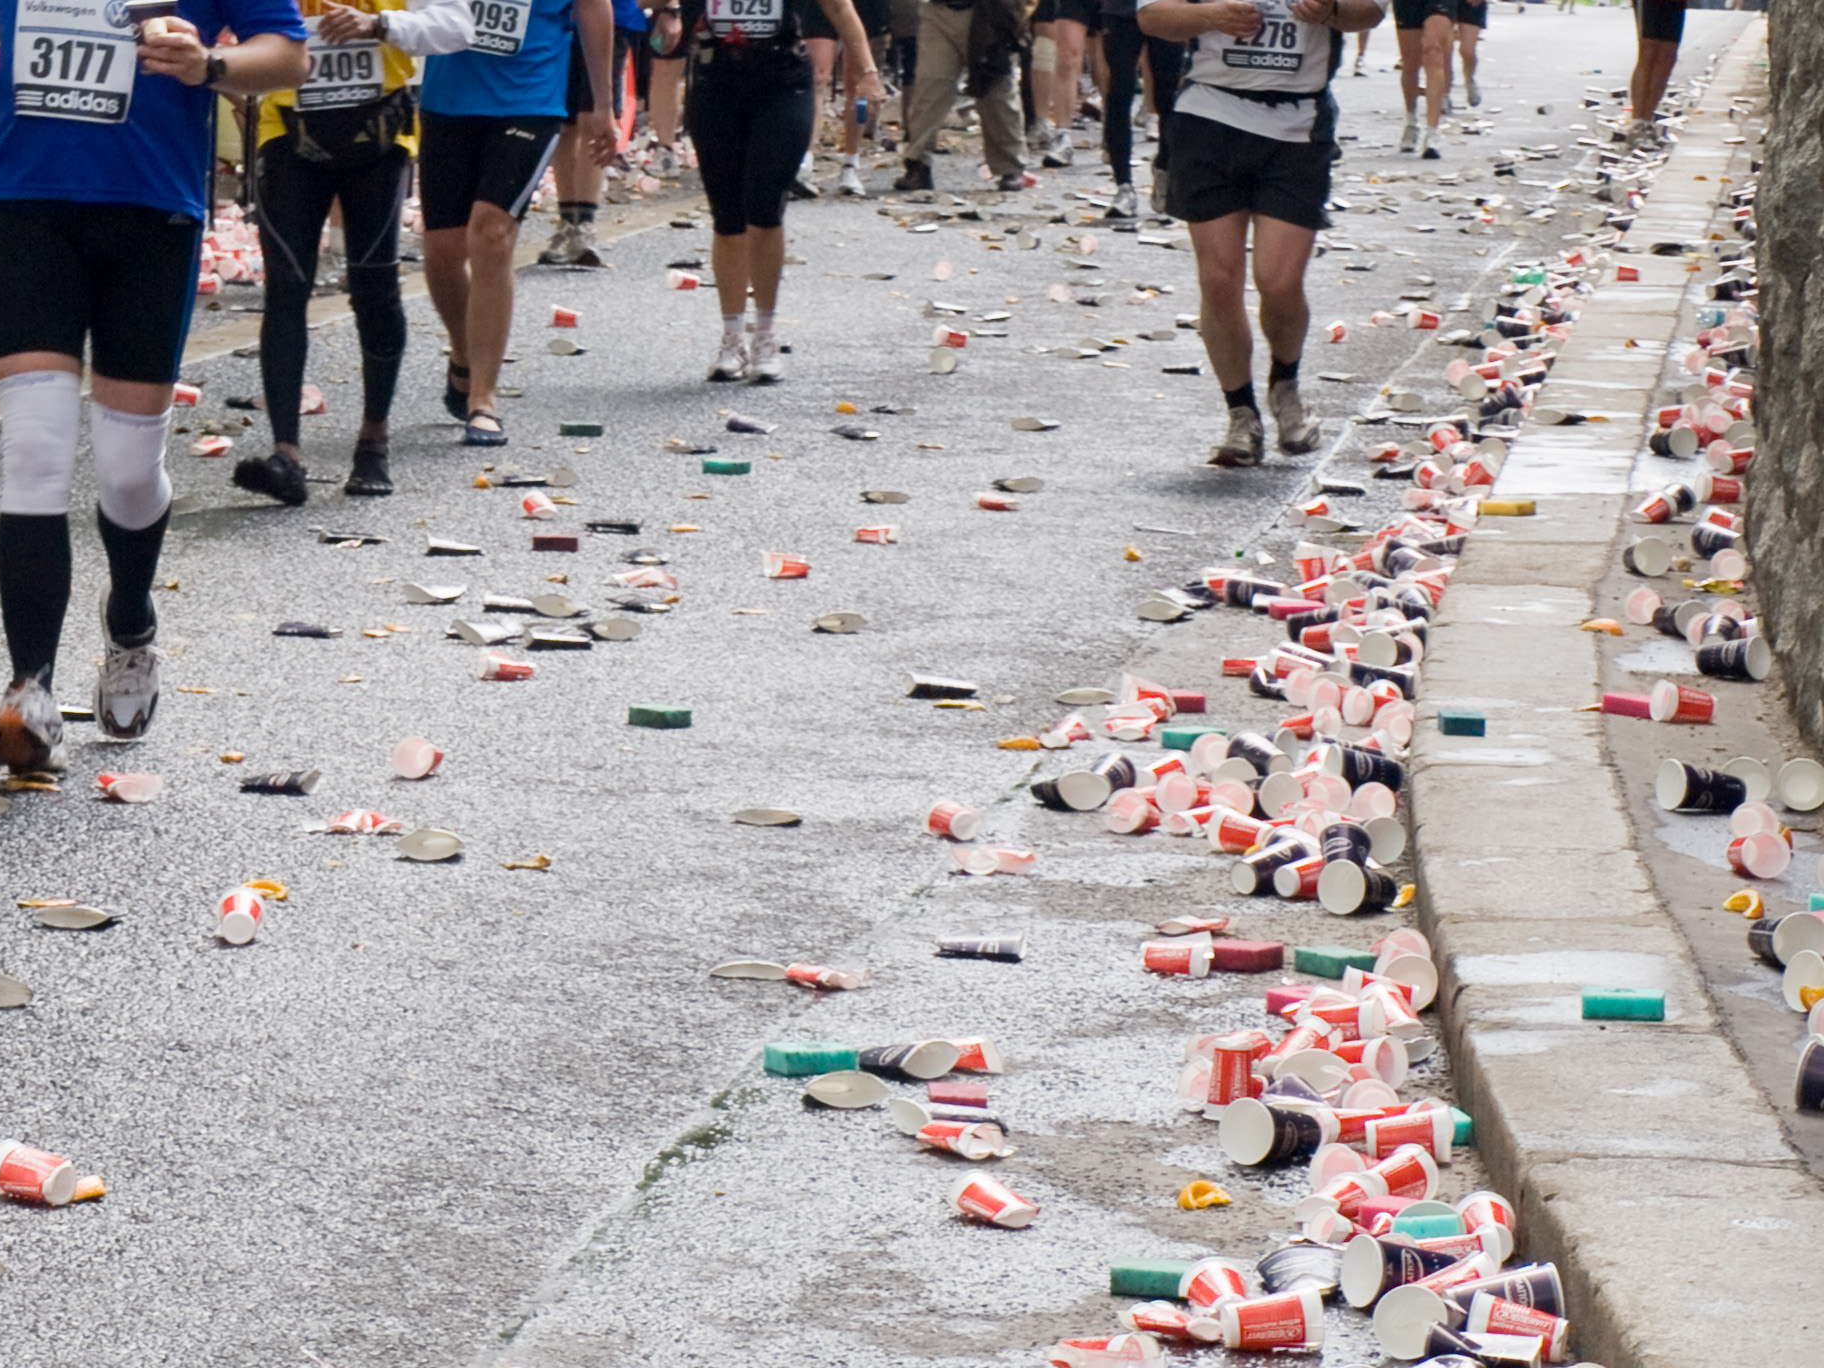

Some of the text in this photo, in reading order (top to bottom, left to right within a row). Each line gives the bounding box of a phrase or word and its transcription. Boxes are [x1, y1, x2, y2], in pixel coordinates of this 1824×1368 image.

[25, 0, 96, 17] Volkswagen
[30, 37, 116, 84] 3177
[1251, 53, 1298, 67] adidas
[46, 90, 120, 114] adidas
